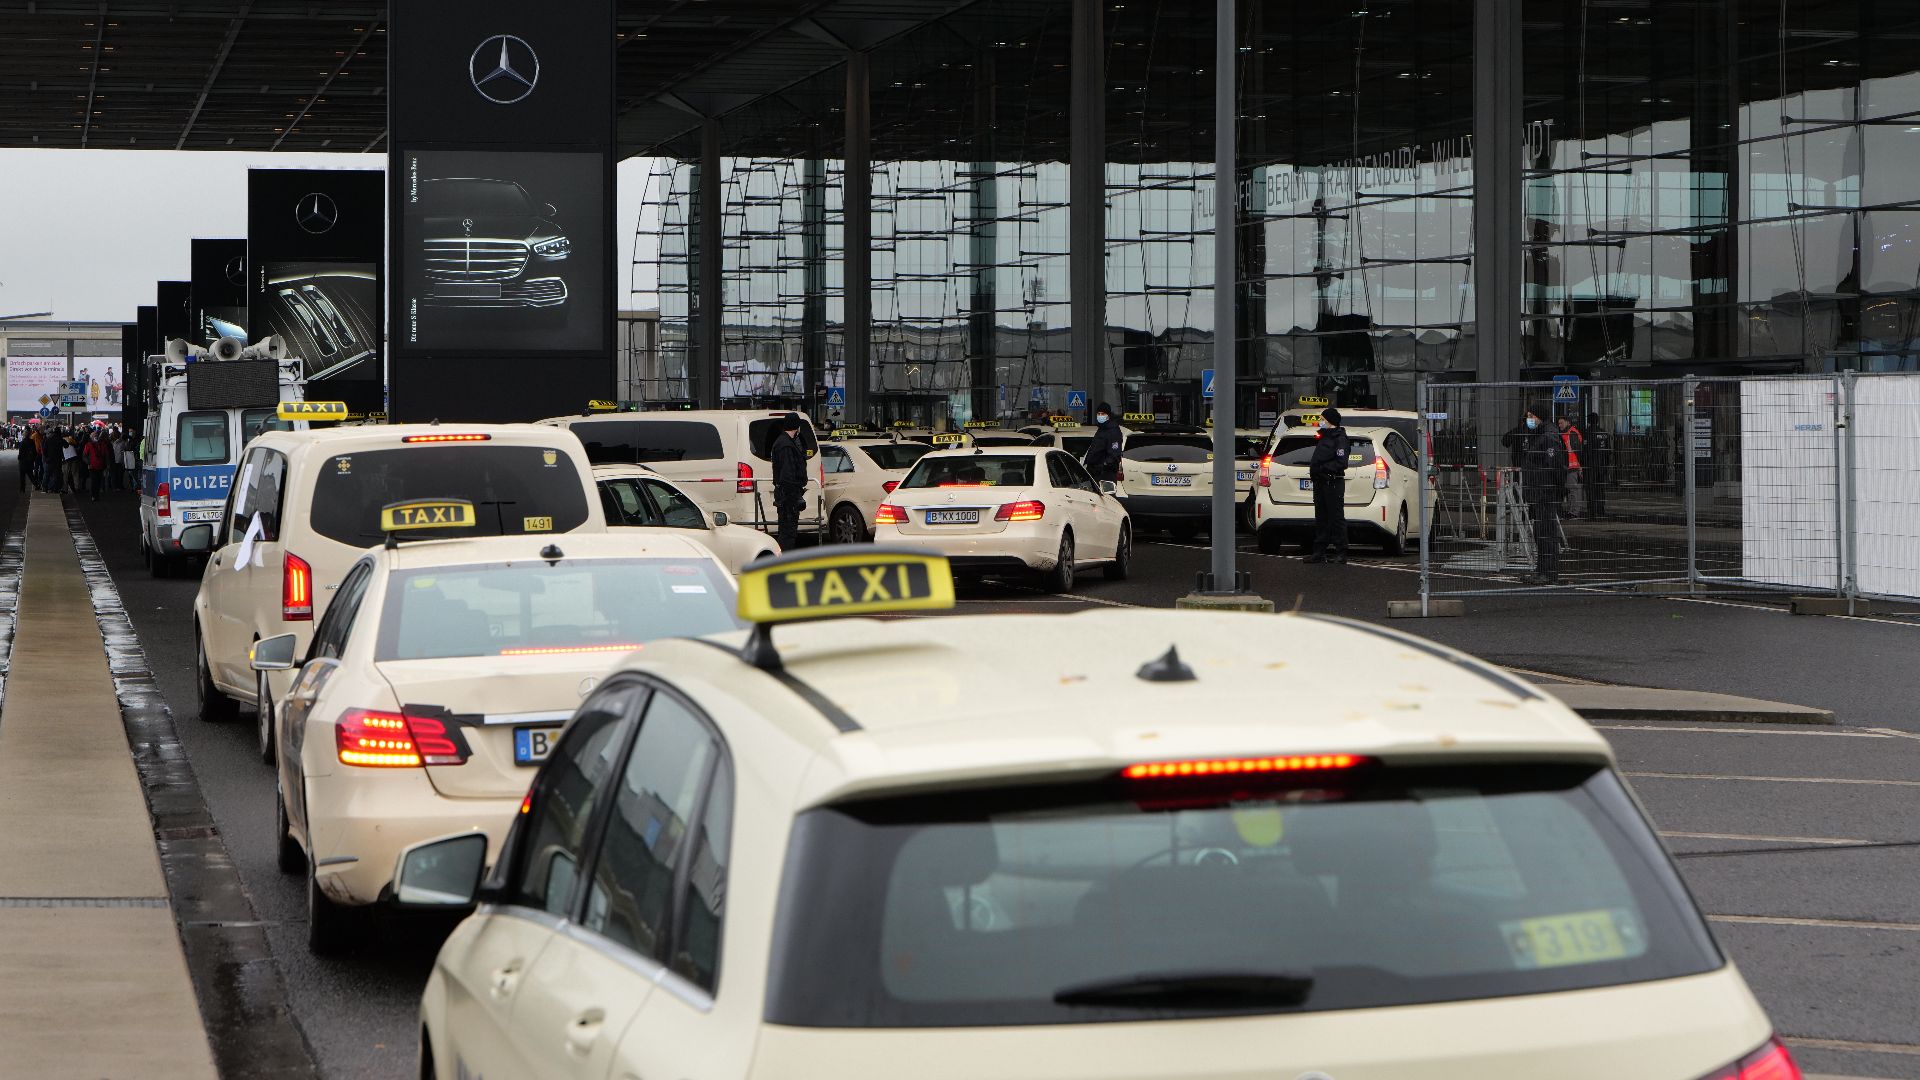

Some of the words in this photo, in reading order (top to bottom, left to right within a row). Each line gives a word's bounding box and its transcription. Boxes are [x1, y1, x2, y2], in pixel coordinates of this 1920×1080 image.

[290, 403, 336, 412] TAXI
[938, 435, 960, 443] TAXI
[401, 506, 456, 524] TAXI
[942, 512, 954, 521] KX
[955, 511, 977, 521] 1008
[526, 518, 551, 529] 1491
[785, 565, 911, 607] TAXI
[532, 732, 549, 756] B
[1536, 919, 1608, 958] 319
